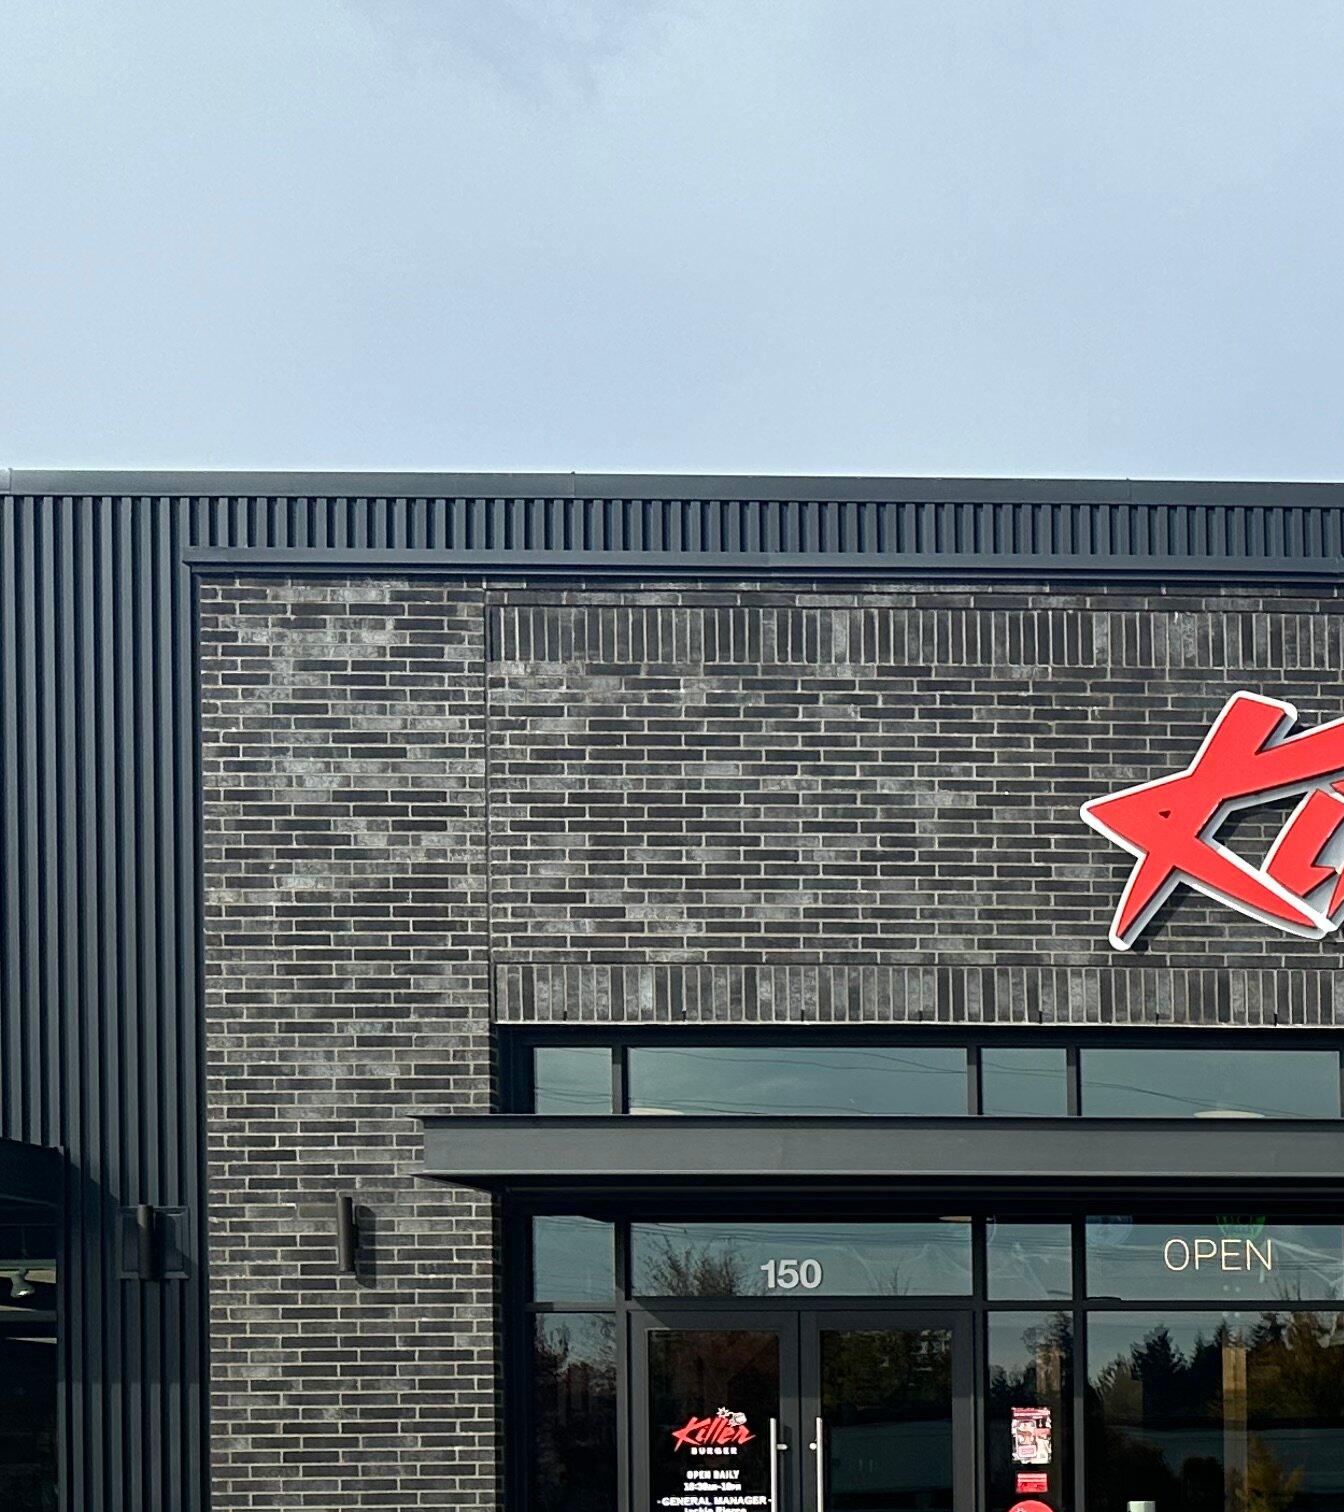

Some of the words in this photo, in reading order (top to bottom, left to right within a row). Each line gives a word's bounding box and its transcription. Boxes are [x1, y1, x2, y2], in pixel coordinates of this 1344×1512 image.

[1164, 1238, 1273, 1271] OPEN
[760, 1258, 823, 1289] 150
[671, 1415, 757, 1453] Killer
[690, 1446, 738, 1455] BURGER
[686, 1470, 711, 1480] OPEN
[712, 1469, 740, 1480] DAILY
[713, 1495, 767, 1505] MANAGER
